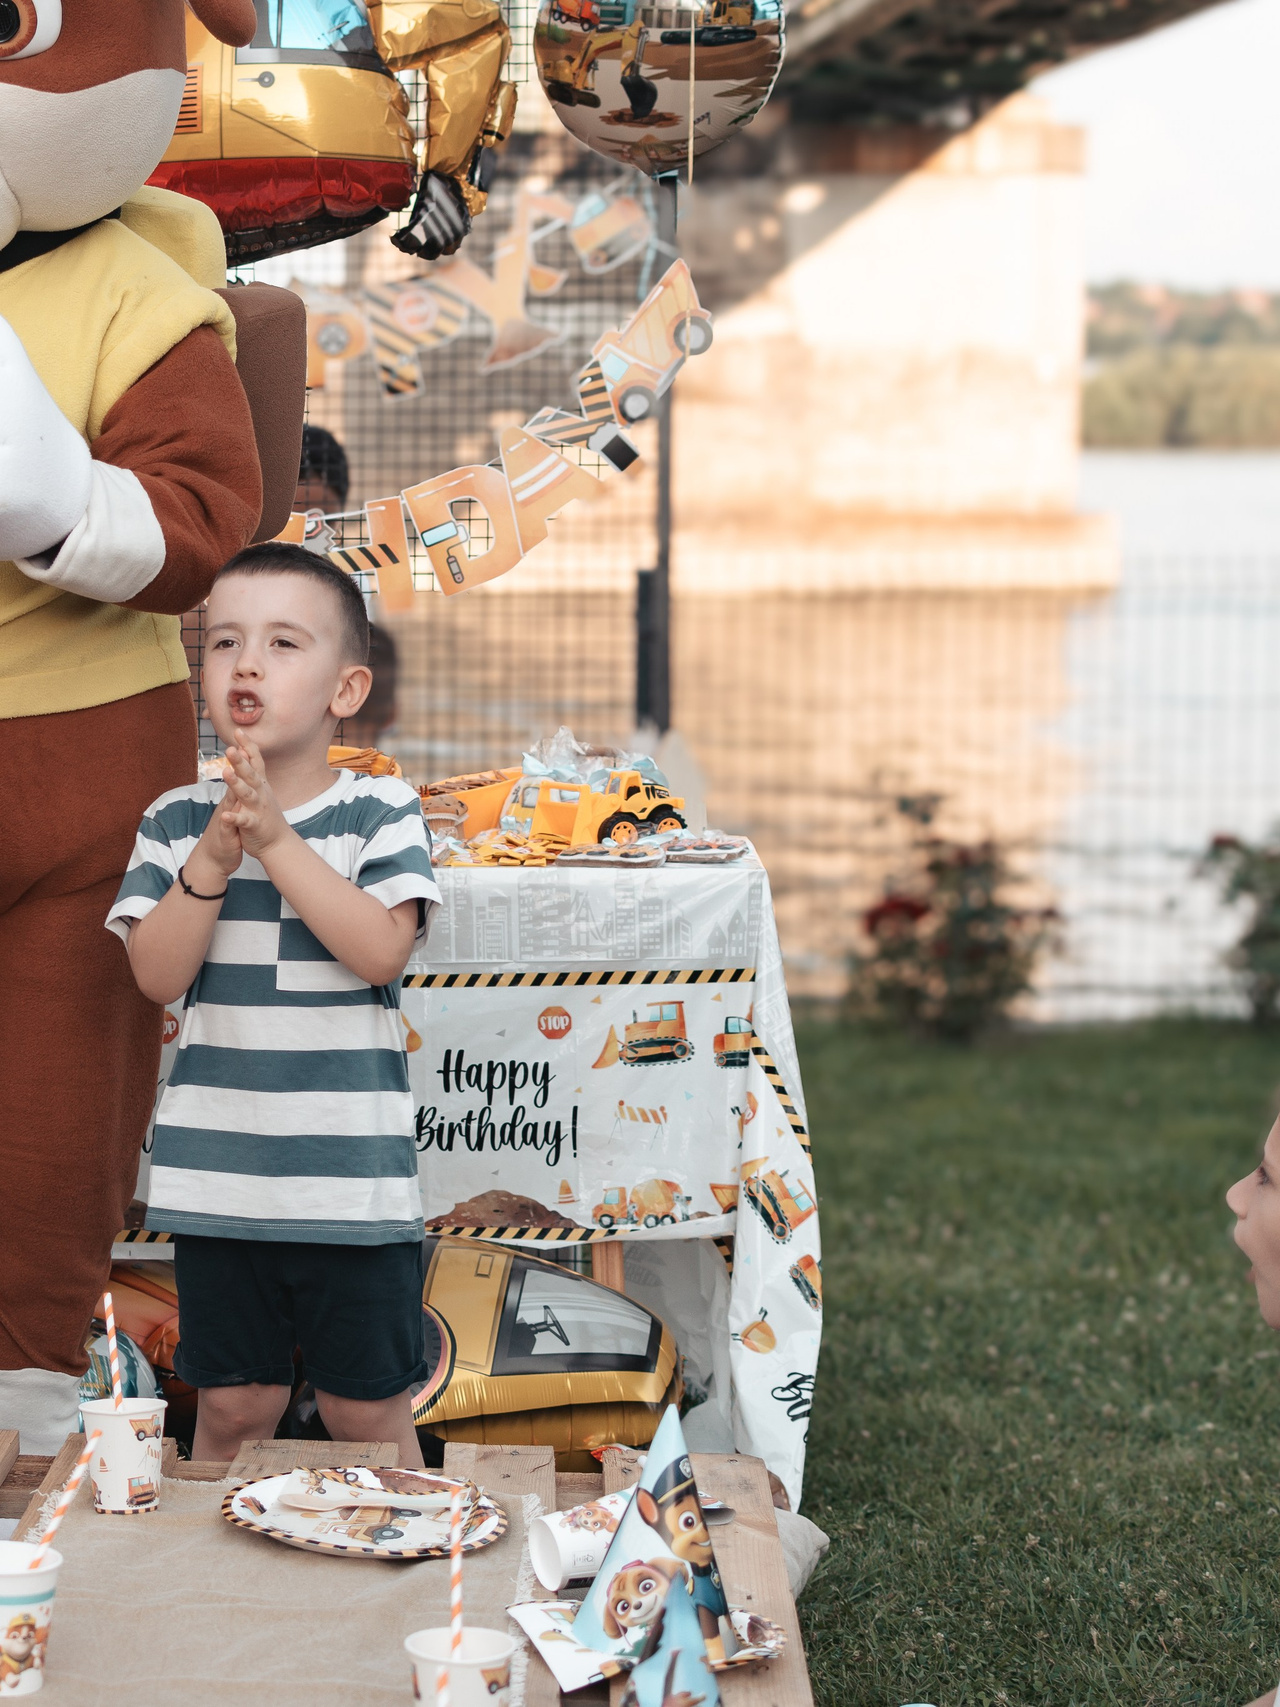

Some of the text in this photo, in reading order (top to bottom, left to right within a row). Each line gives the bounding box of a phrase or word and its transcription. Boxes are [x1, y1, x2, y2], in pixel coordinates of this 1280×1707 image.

[540, 1015, 570, 1031] STOP
[436, 1049, 556, 1108] Happy
[414, 1105, 578, 1167] Birthday!
